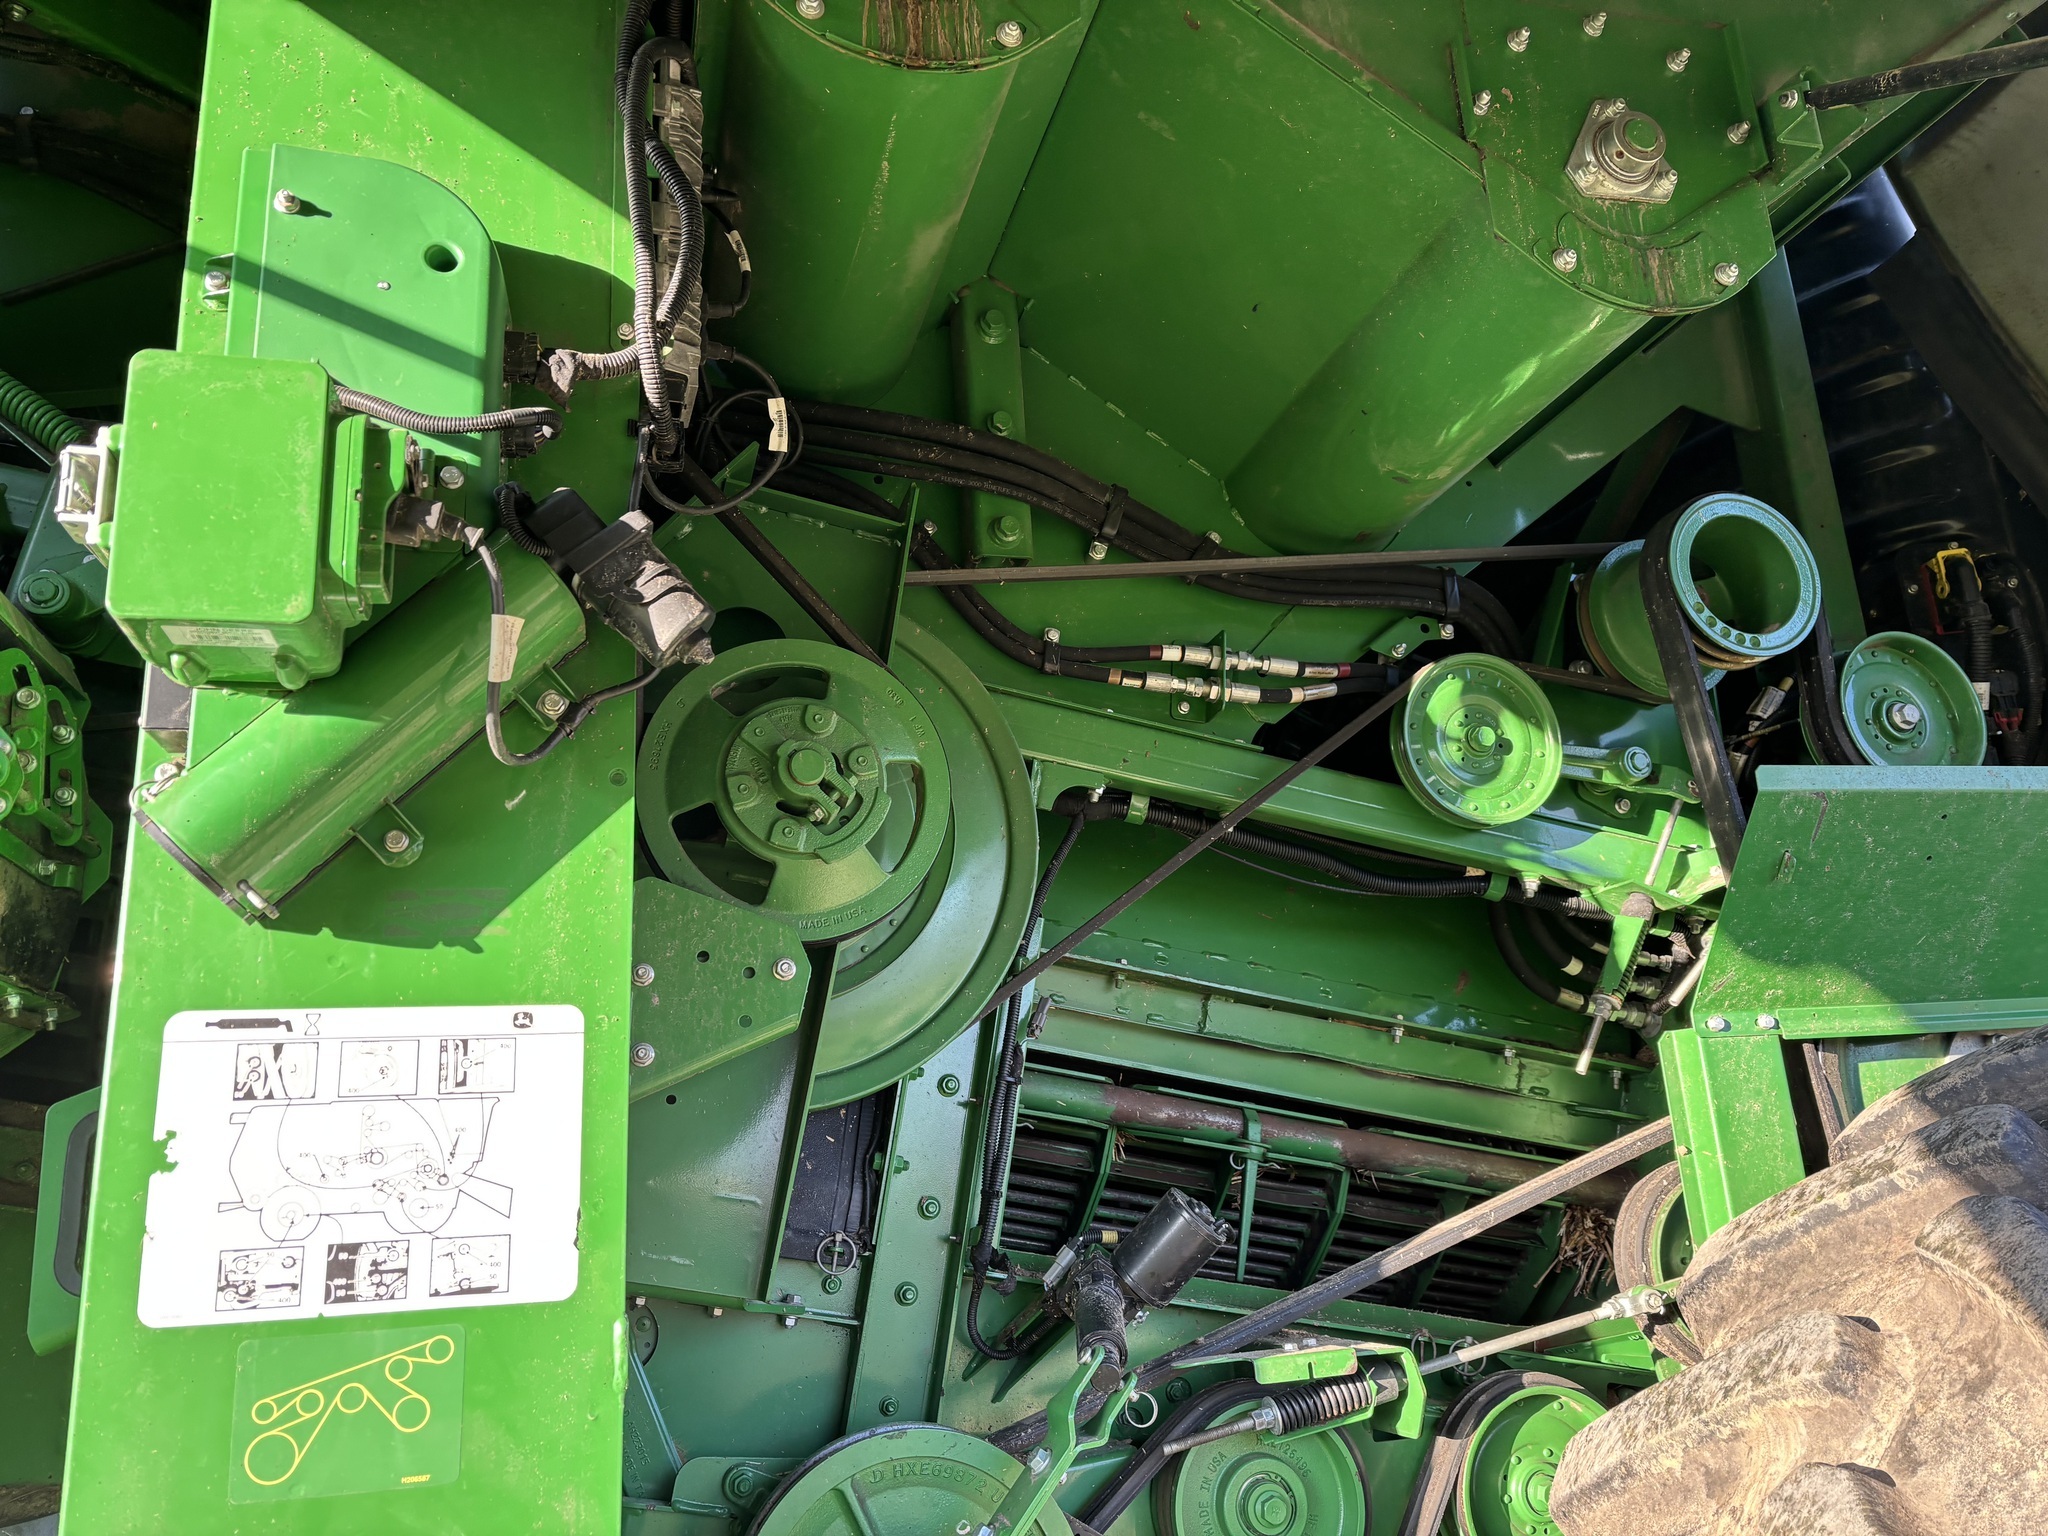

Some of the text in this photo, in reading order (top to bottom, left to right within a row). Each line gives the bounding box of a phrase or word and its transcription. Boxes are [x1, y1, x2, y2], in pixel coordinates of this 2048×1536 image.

[799, 906, 867, 930] MADE IN USA
[1207, 1450, 1228, 1474] USA
[892, 1461, 988, 1496] HXE69872
